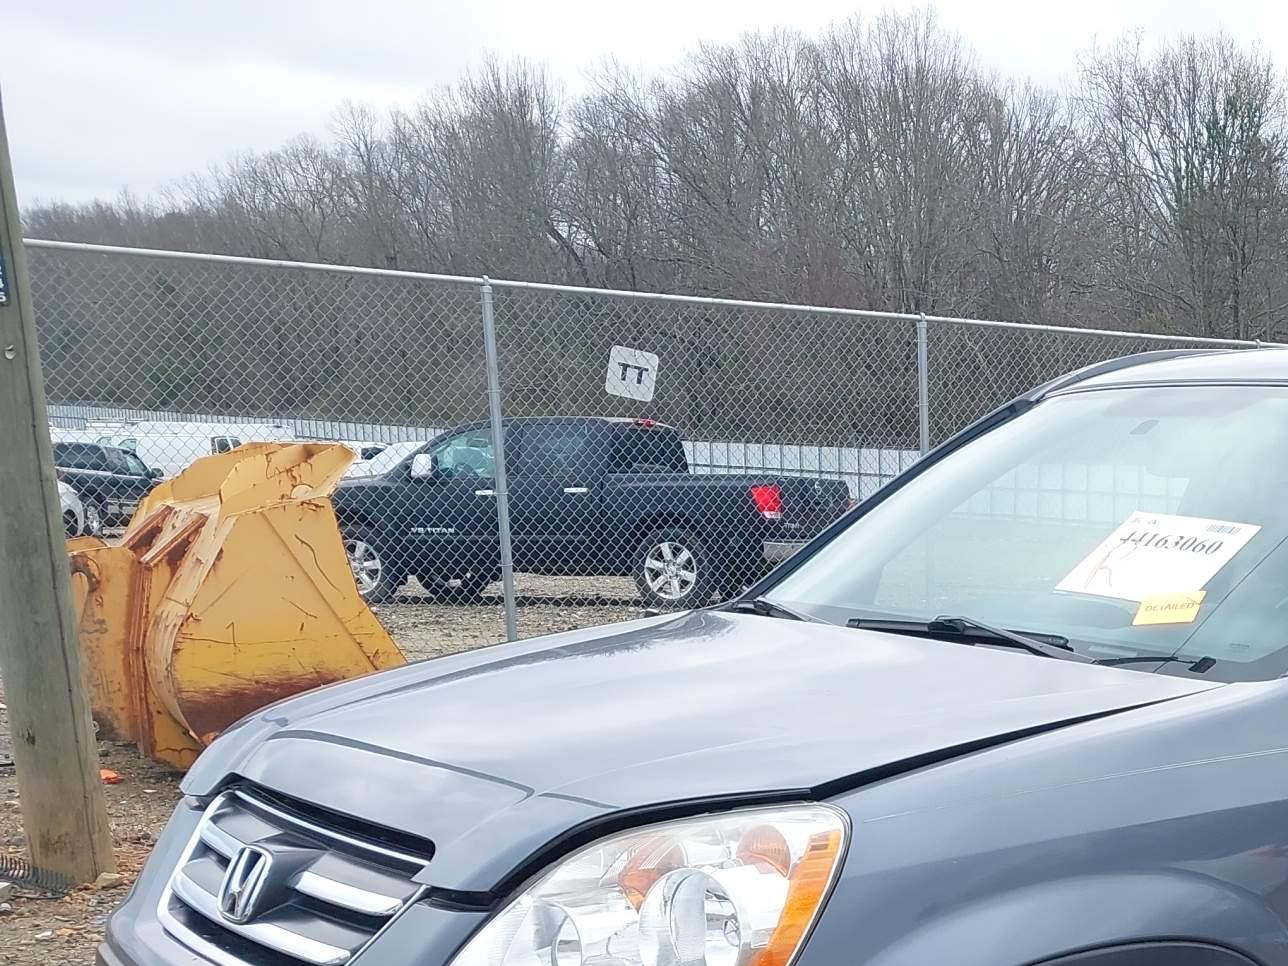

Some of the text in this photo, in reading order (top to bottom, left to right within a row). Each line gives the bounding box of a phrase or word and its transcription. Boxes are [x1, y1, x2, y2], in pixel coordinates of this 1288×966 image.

[617, 361, 649, 385] TT
[1120, 529, 1224, 555] 44163060
[1145, 600, 1196, 613] DETAILED
